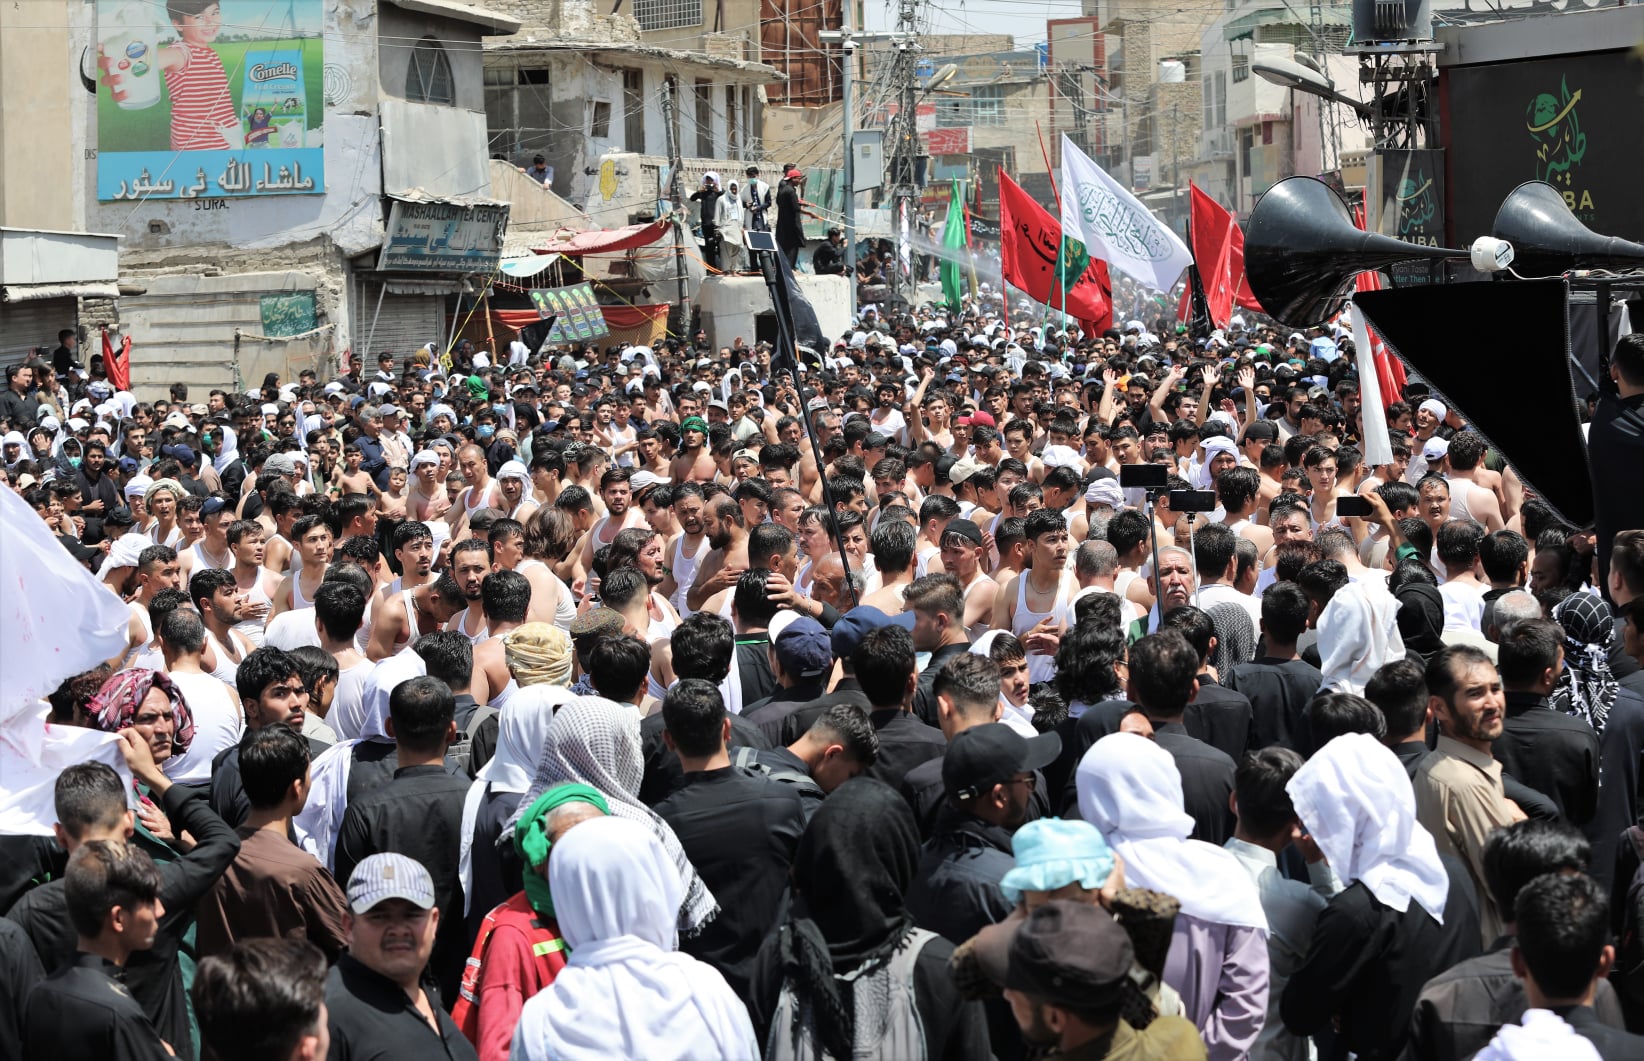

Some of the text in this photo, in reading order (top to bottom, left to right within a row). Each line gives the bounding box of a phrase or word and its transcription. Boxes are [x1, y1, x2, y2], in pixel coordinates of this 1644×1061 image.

[249, 62, 297, 83] Comelle
[401, 205, 457, 222] MASHAALLAH
[460, 208, 475, 223] TEA
